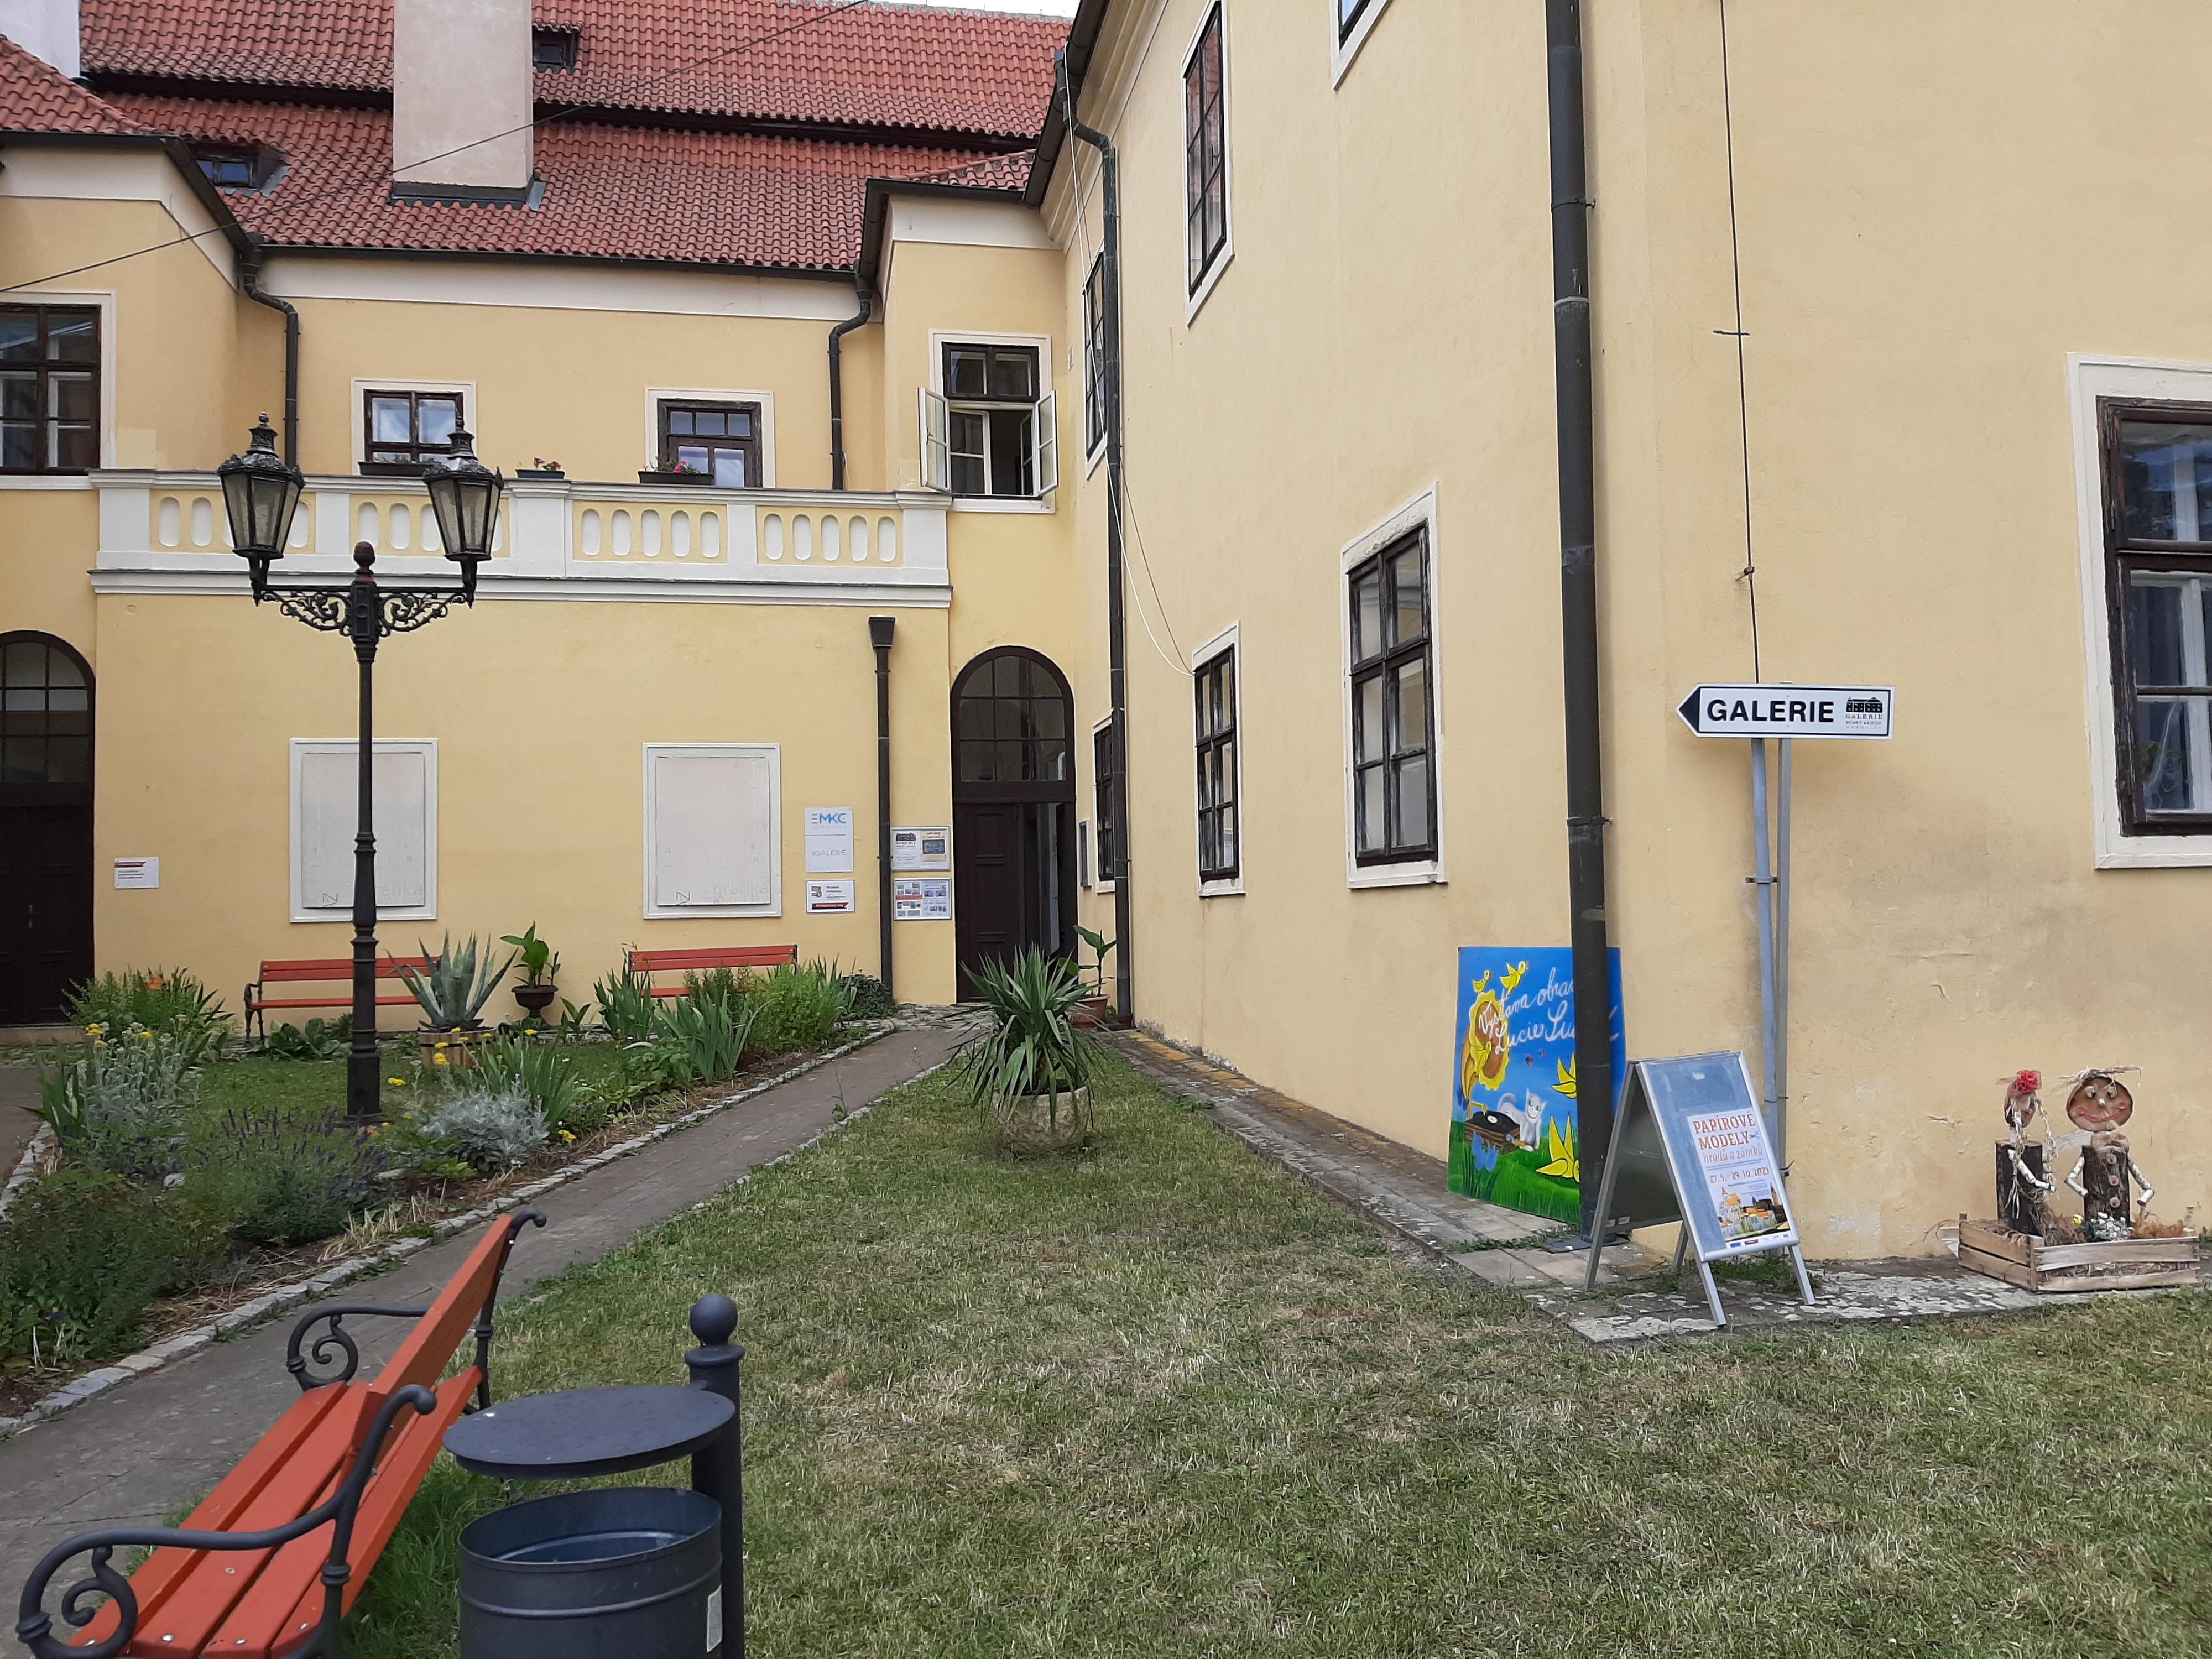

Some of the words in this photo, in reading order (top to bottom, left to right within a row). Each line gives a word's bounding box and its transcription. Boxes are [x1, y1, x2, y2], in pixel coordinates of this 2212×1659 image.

[1707, 699, 1835, 723] GALERIE
[1536, 966, 1574, 1006] obra
[1693, 1111, 1756, 1134] PAPÍROVÉ
[1698, 1131, 1749, 1150] MODELY
